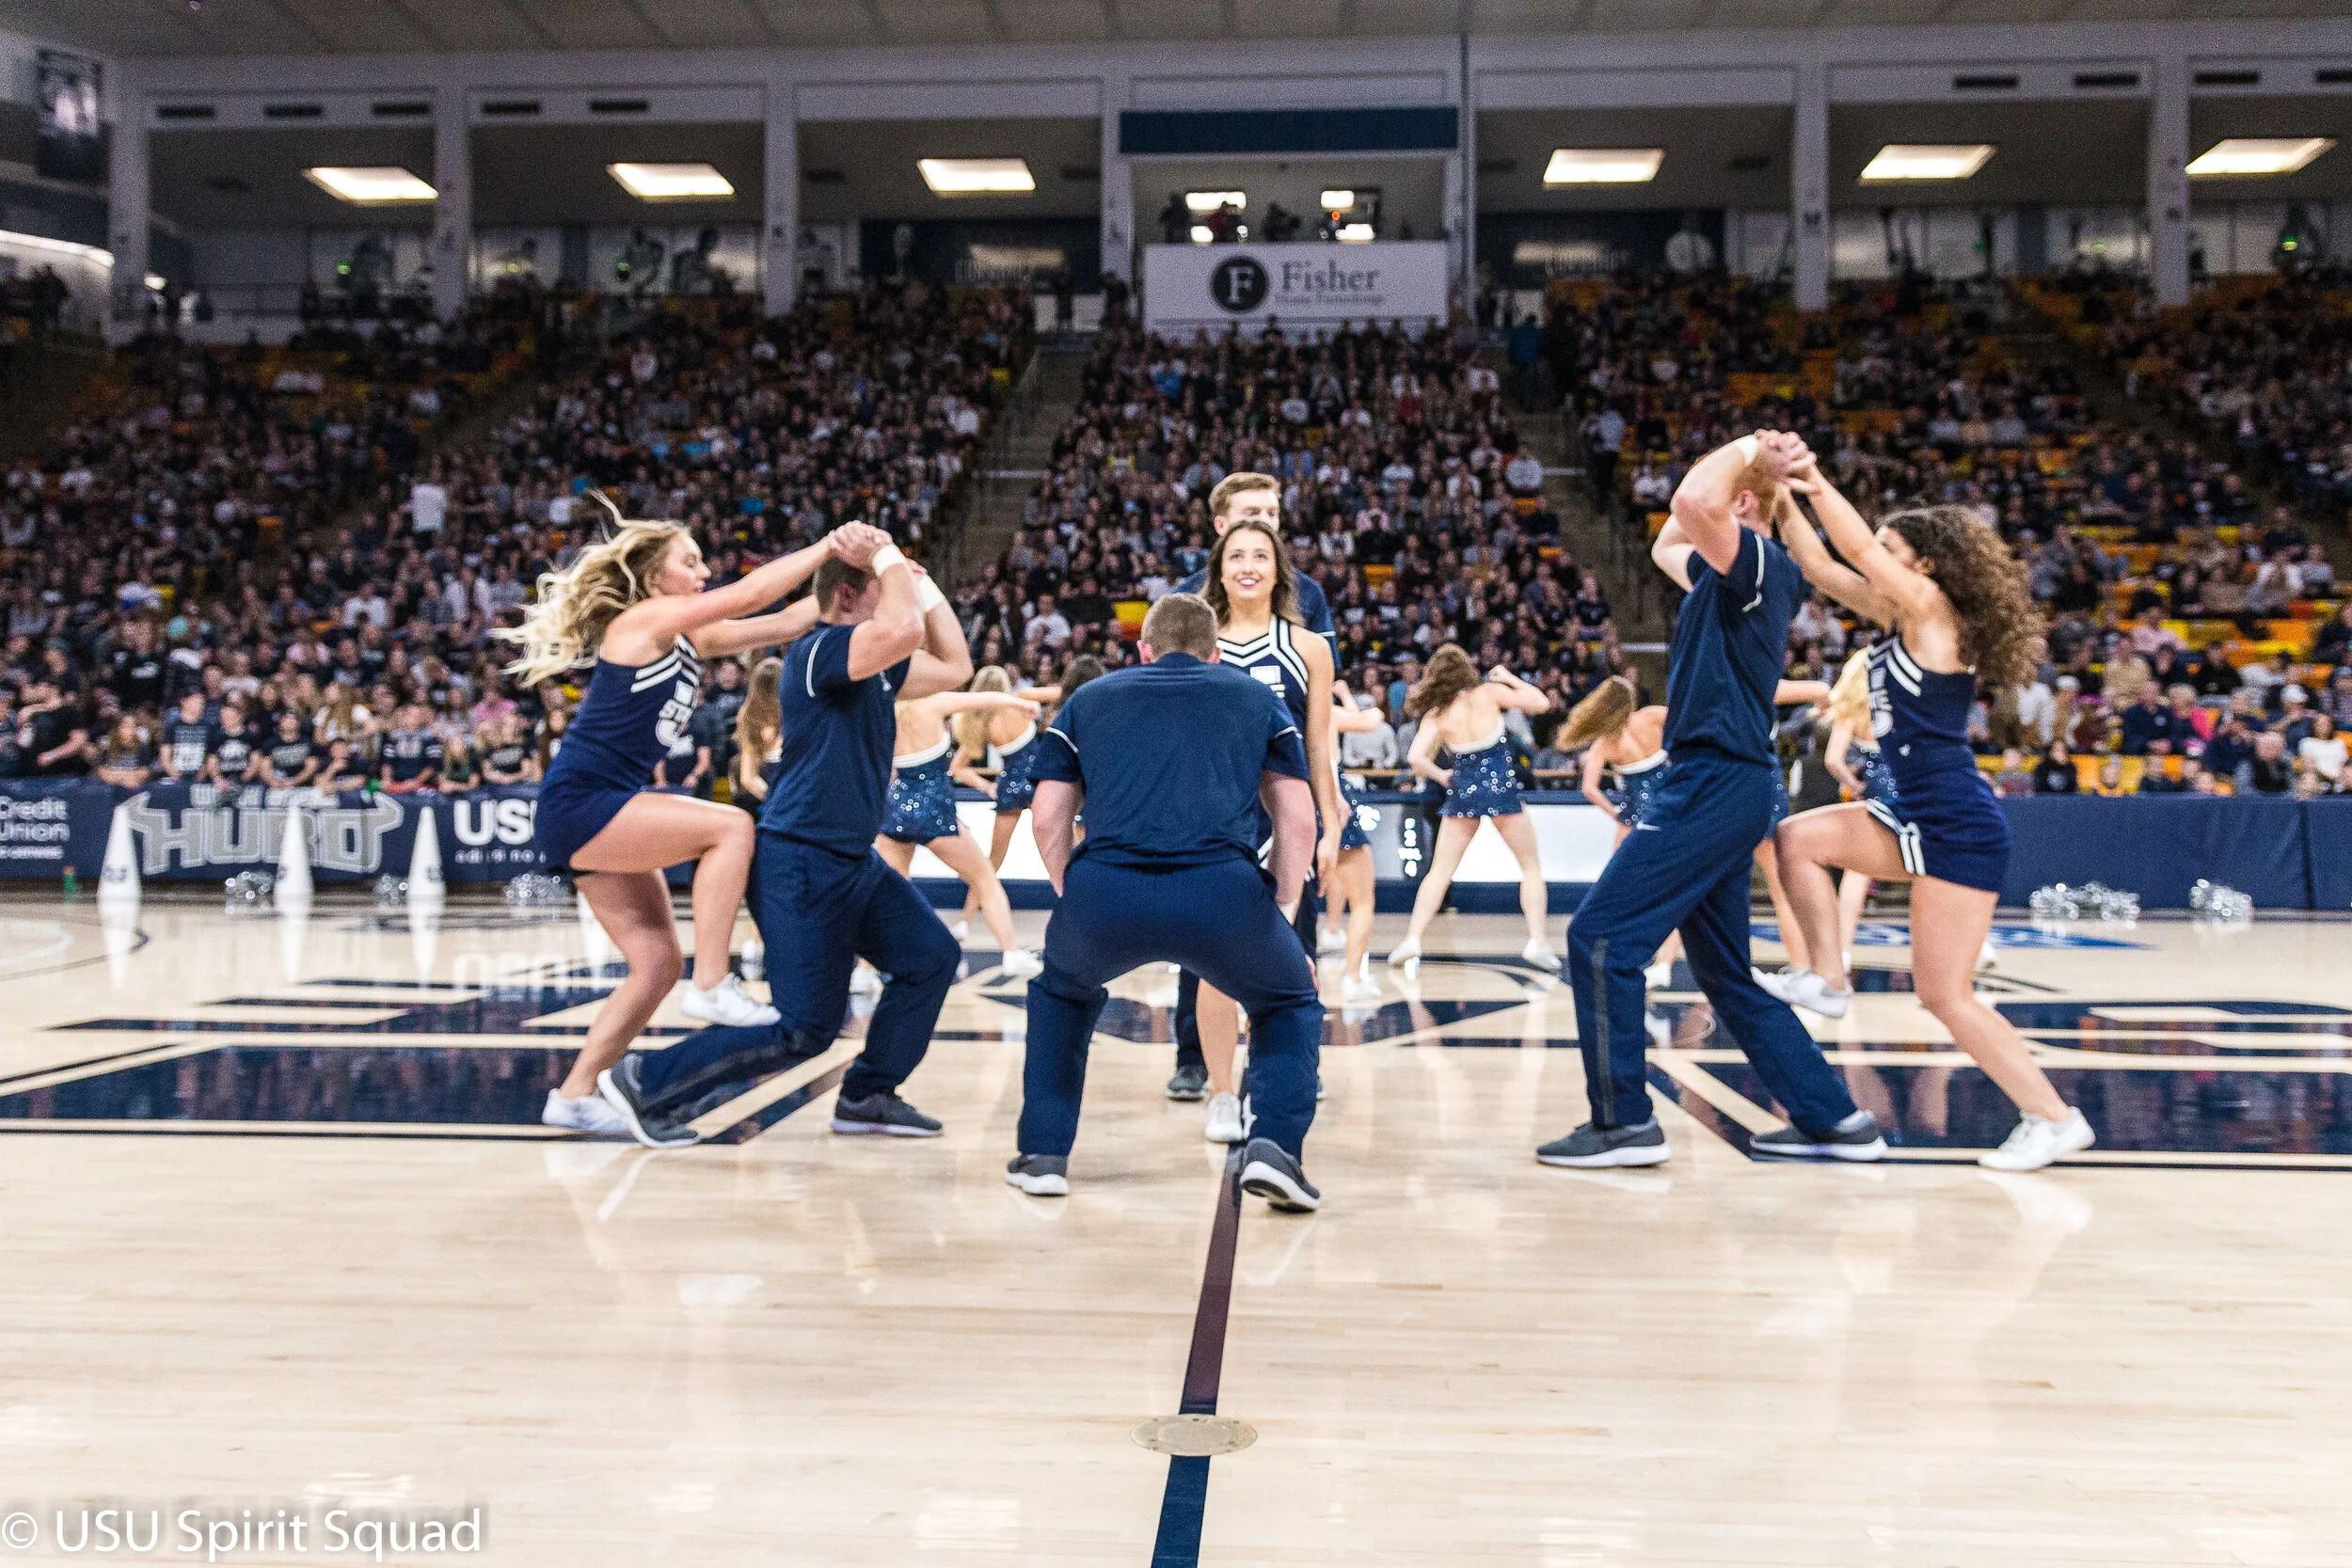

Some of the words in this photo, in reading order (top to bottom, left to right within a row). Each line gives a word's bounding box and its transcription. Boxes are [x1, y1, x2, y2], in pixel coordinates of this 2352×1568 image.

[1228, 265, 1255, 305] F
[1280, 259, 1380, 291] Fisher
[0, 796, 68, 820] Credit
[453, 799, 538, 847] US
